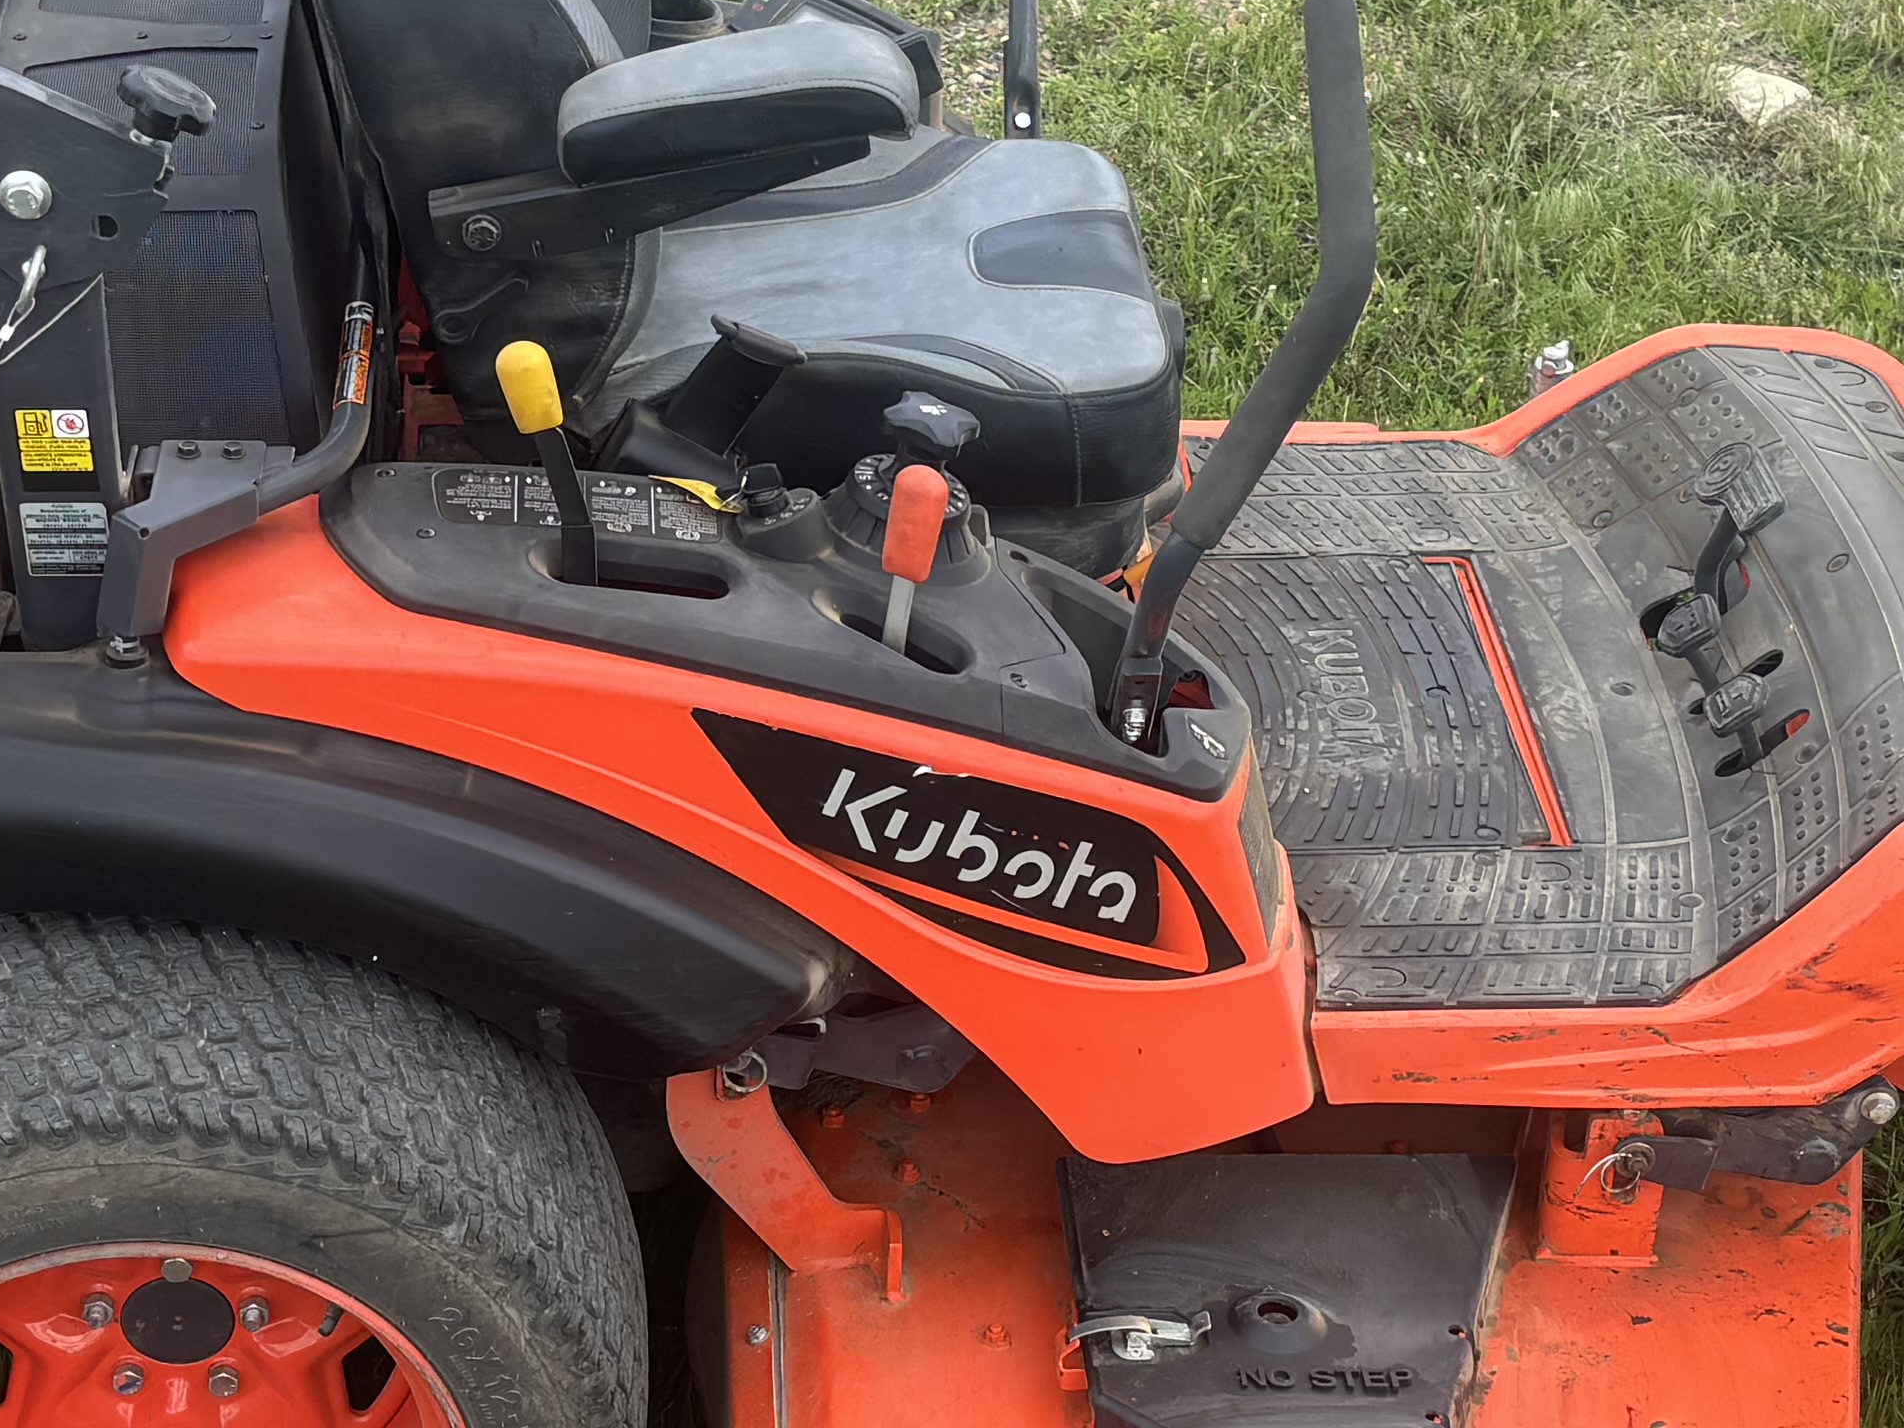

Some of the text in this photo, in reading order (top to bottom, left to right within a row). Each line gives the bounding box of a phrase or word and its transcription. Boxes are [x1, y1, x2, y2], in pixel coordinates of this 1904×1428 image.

[1299, 629, 1395, 767] KUBOTA
[821, 768, 1137, 924] Kubota
[1237, 1366, 1414, 1395] NO STEP
